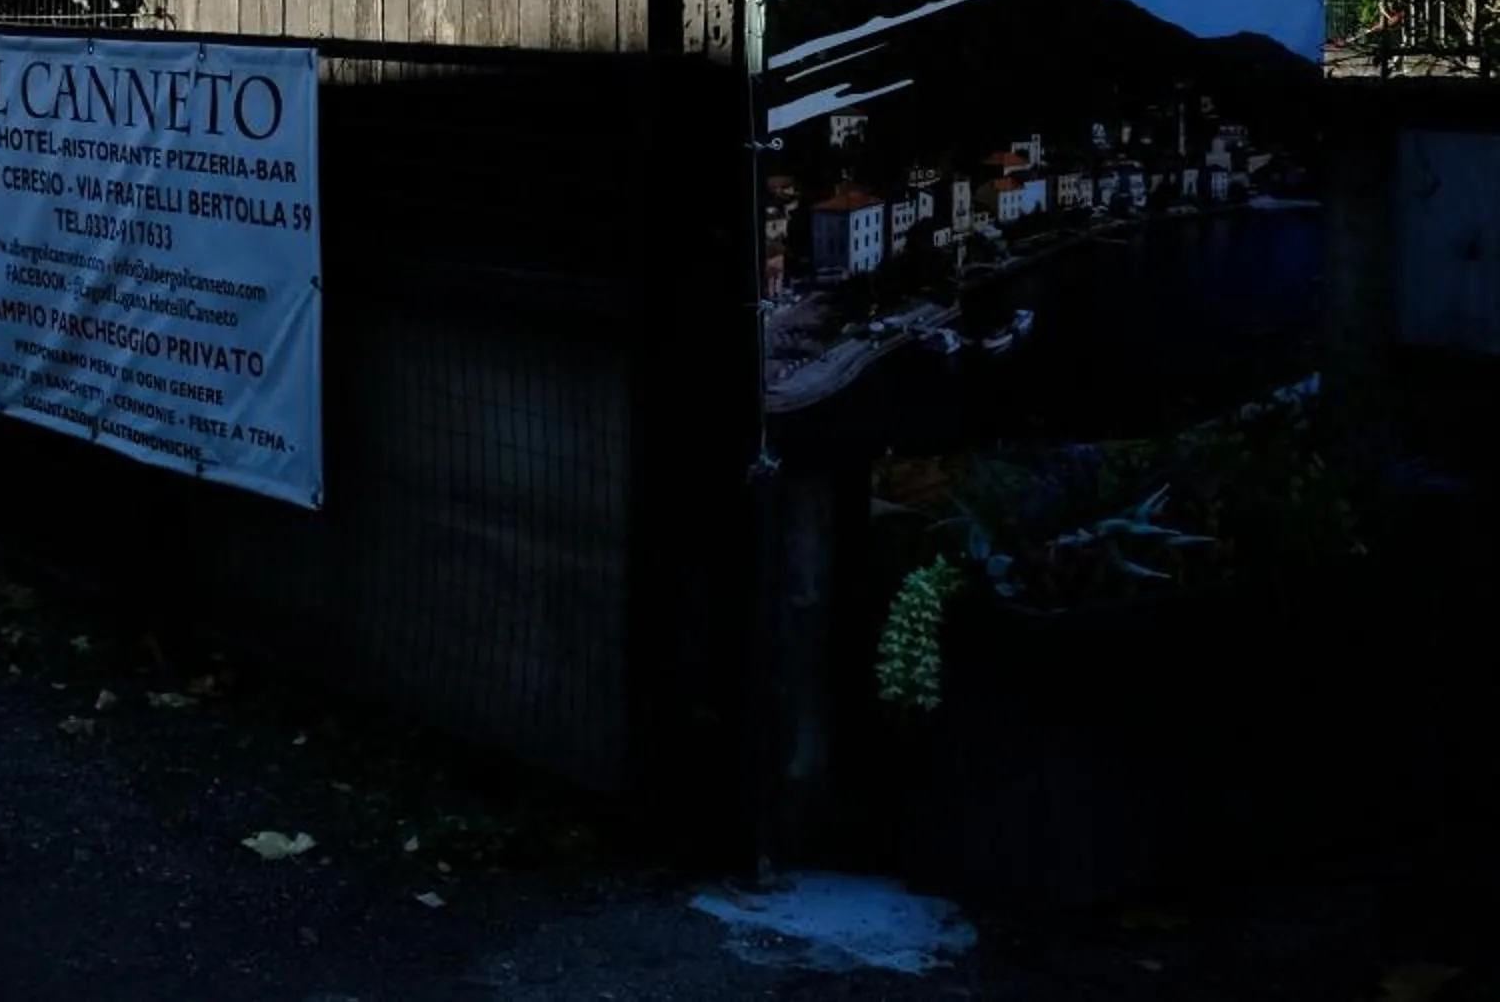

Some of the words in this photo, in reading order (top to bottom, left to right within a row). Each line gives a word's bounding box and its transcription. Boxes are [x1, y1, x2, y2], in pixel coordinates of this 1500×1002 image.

[21, 60, 283, 140] CANNETO
[166, 148, 296, 183] PIZZERIA-BAR
[2, 165, 64, 196] CERESIO
[77, 174, 102, 202] VIA
[105, 178, 182, 214] FRATELLI
[188, 189, 286, 229] BERTOLLA
[293, 203, 311, 231] 59
[51, 308, 160, 356] PARCHEGGIO
[166, 335, 263, 377] PRIVATO
[136, 370, 167, 392] OGNI
[170, 379, 224, 406] GENERE
[230, 424, 244, 442] A
